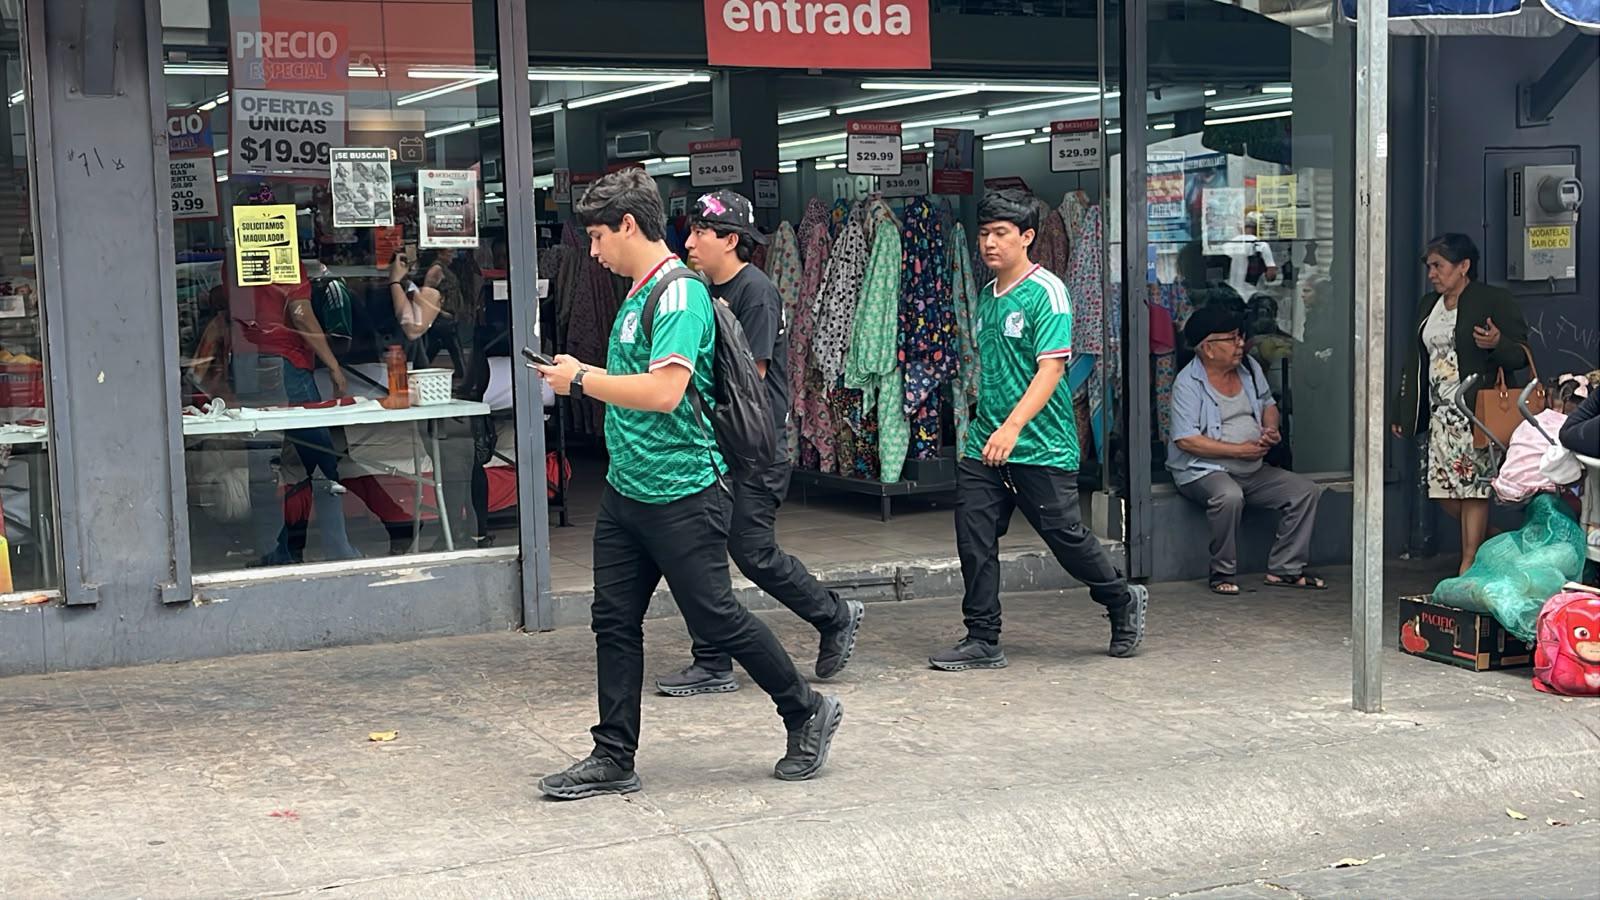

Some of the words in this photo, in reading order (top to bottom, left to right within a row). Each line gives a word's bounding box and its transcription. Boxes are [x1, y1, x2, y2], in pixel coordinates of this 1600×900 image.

[722, 0, 912, 36] entrada
[236, 31, 338, 59] PRECIO
[250, 62, 327, 80] ESPECIAL
[240, 96, 334, 117] OFERTAS
[167, 113, 203, 137] CIO
[249, 112, 327, 134] ÚNICAS
[240, 136, 331, 165] $19.99
[335, 152, 349, 160] ¡SE
[350, 152, 386, 160] BUSCAN!
[856, 151, 894, 161] $29.99
[1059, 147, 1097, 158] $29.99
[698, 164, 734, 175] $24.99
[172, 190, 194, 199] OLO
[241, 220, 285, 231] SOLICITAMOS
[242, 233, 285, 242] MAQUILADOR
[1421, 612, 1456, 629] PACIFIC
